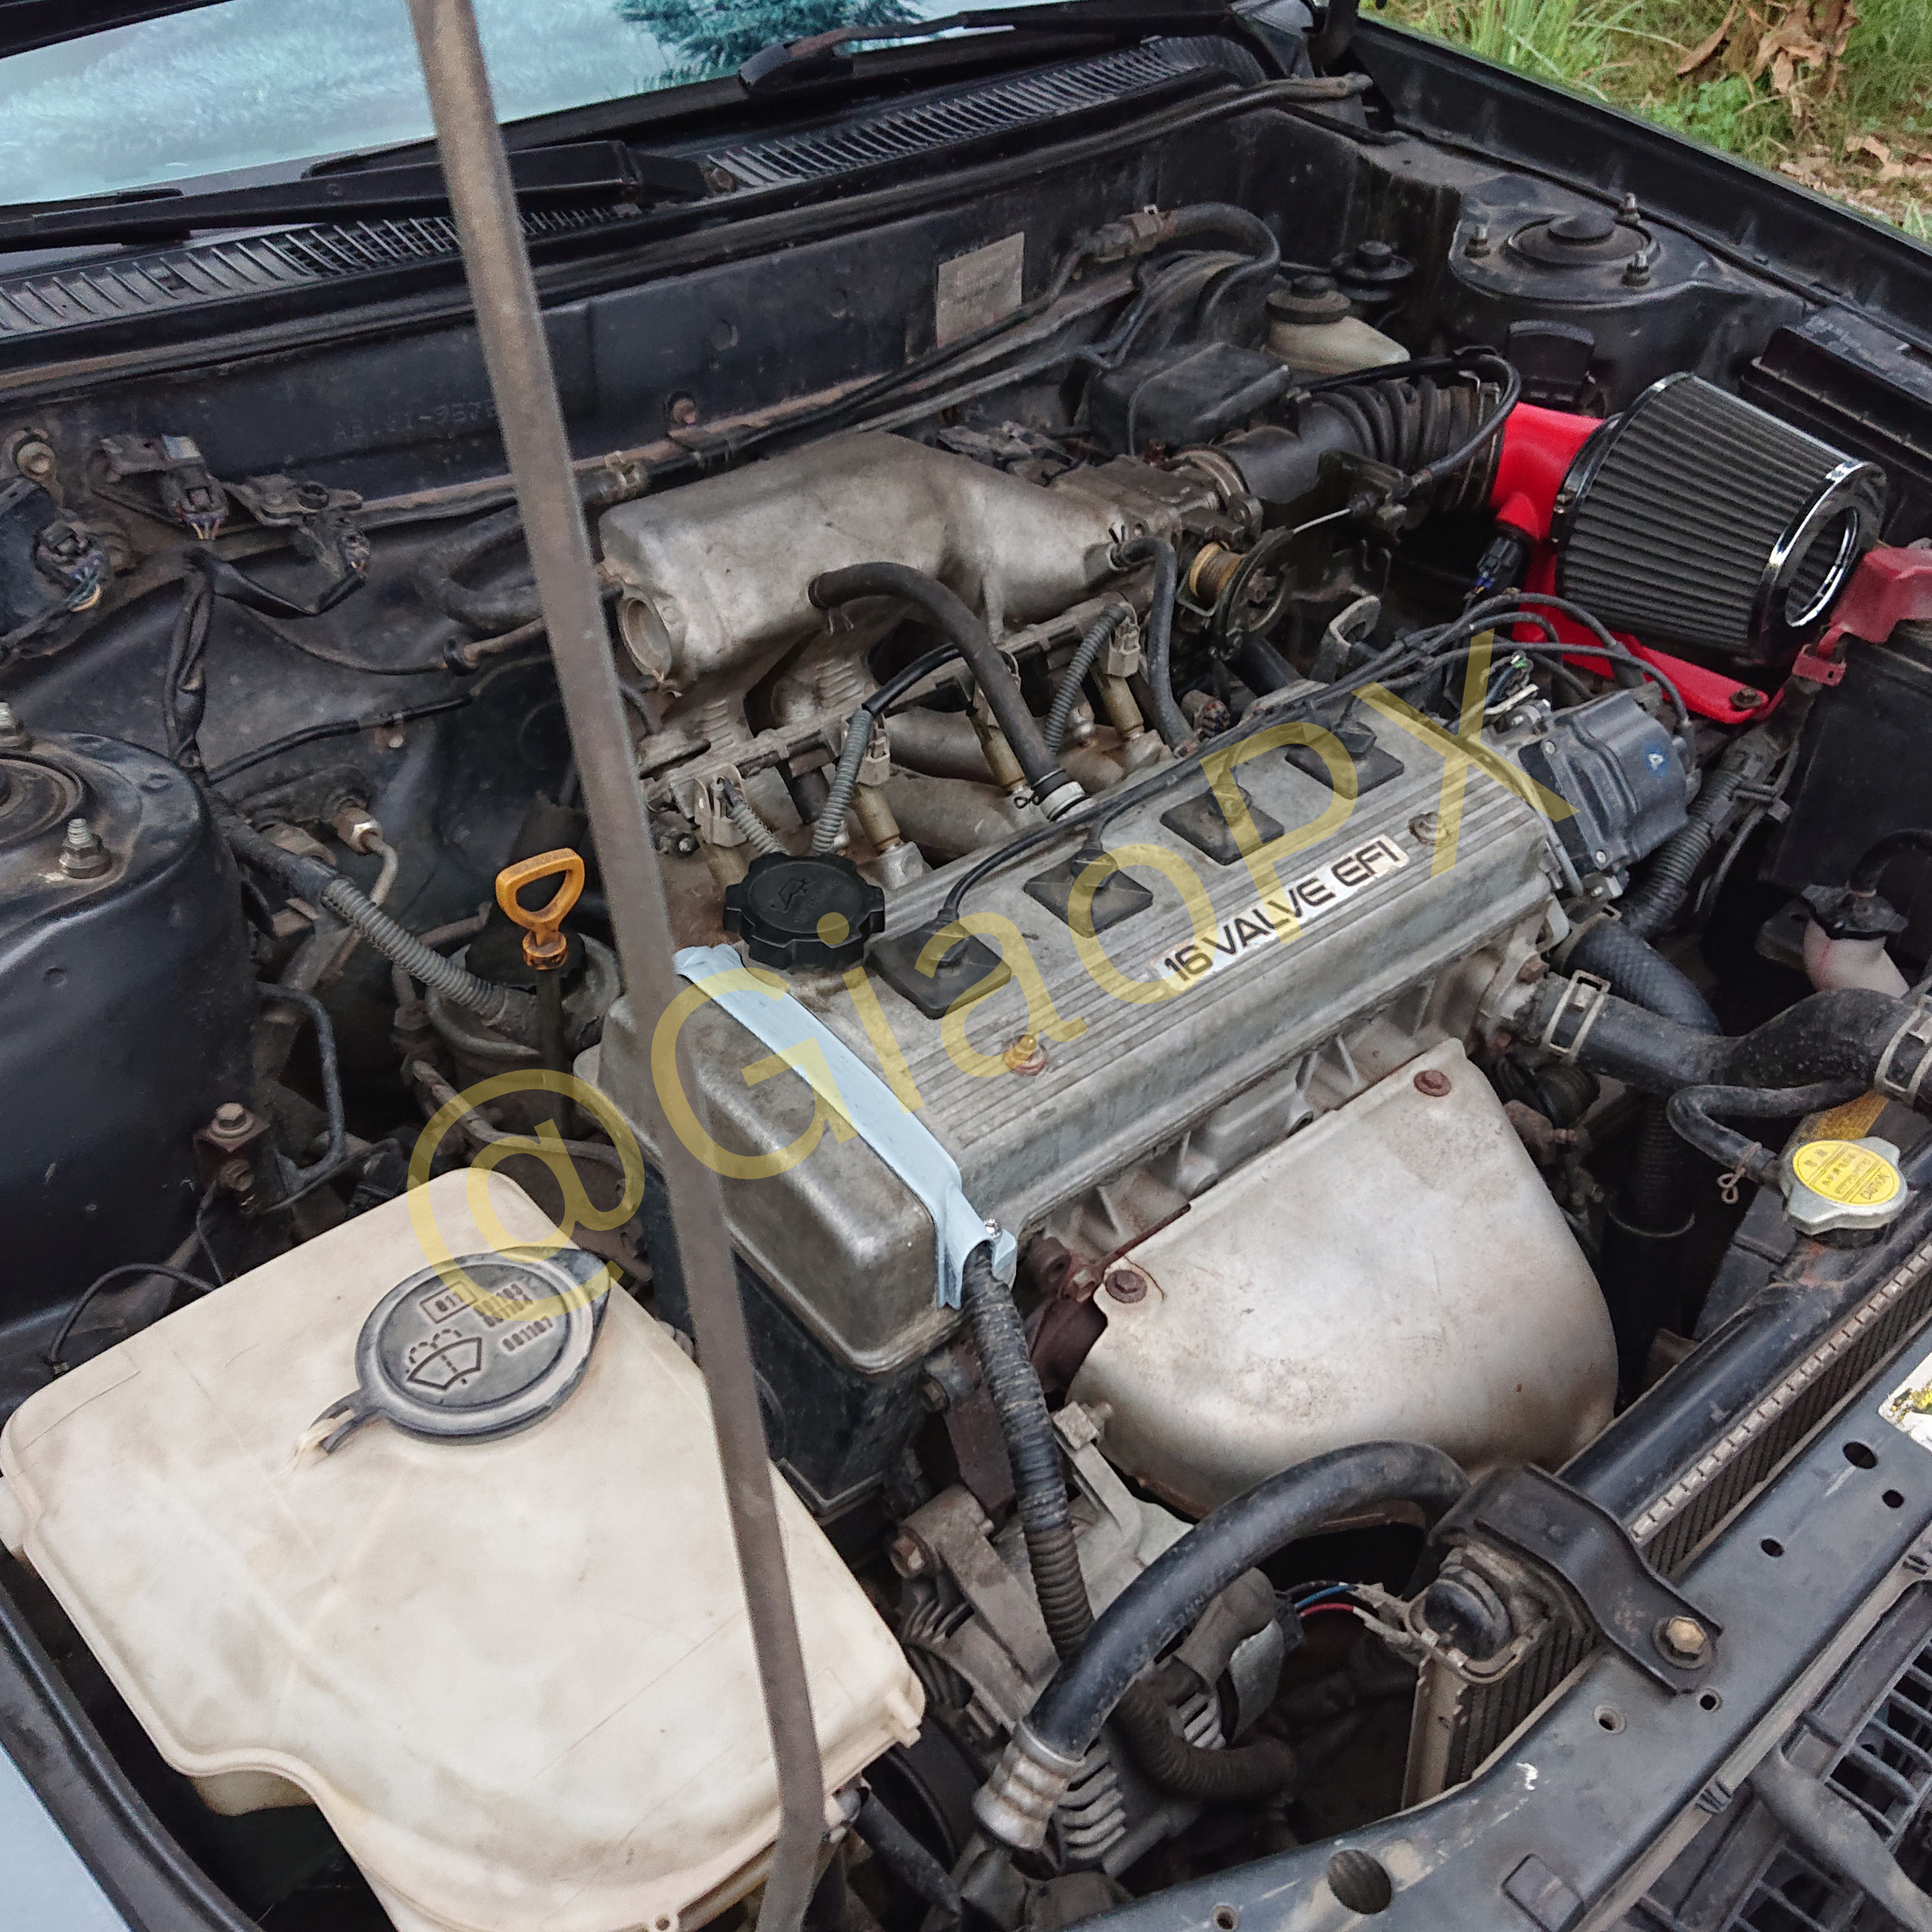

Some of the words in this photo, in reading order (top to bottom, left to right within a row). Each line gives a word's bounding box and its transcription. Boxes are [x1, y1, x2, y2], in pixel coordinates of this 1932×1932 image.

[1164, 945, 1214, 981] 16
[1202, 877, 1336, 955] VALVE
[1330, 839, 1399, 887] EFI
